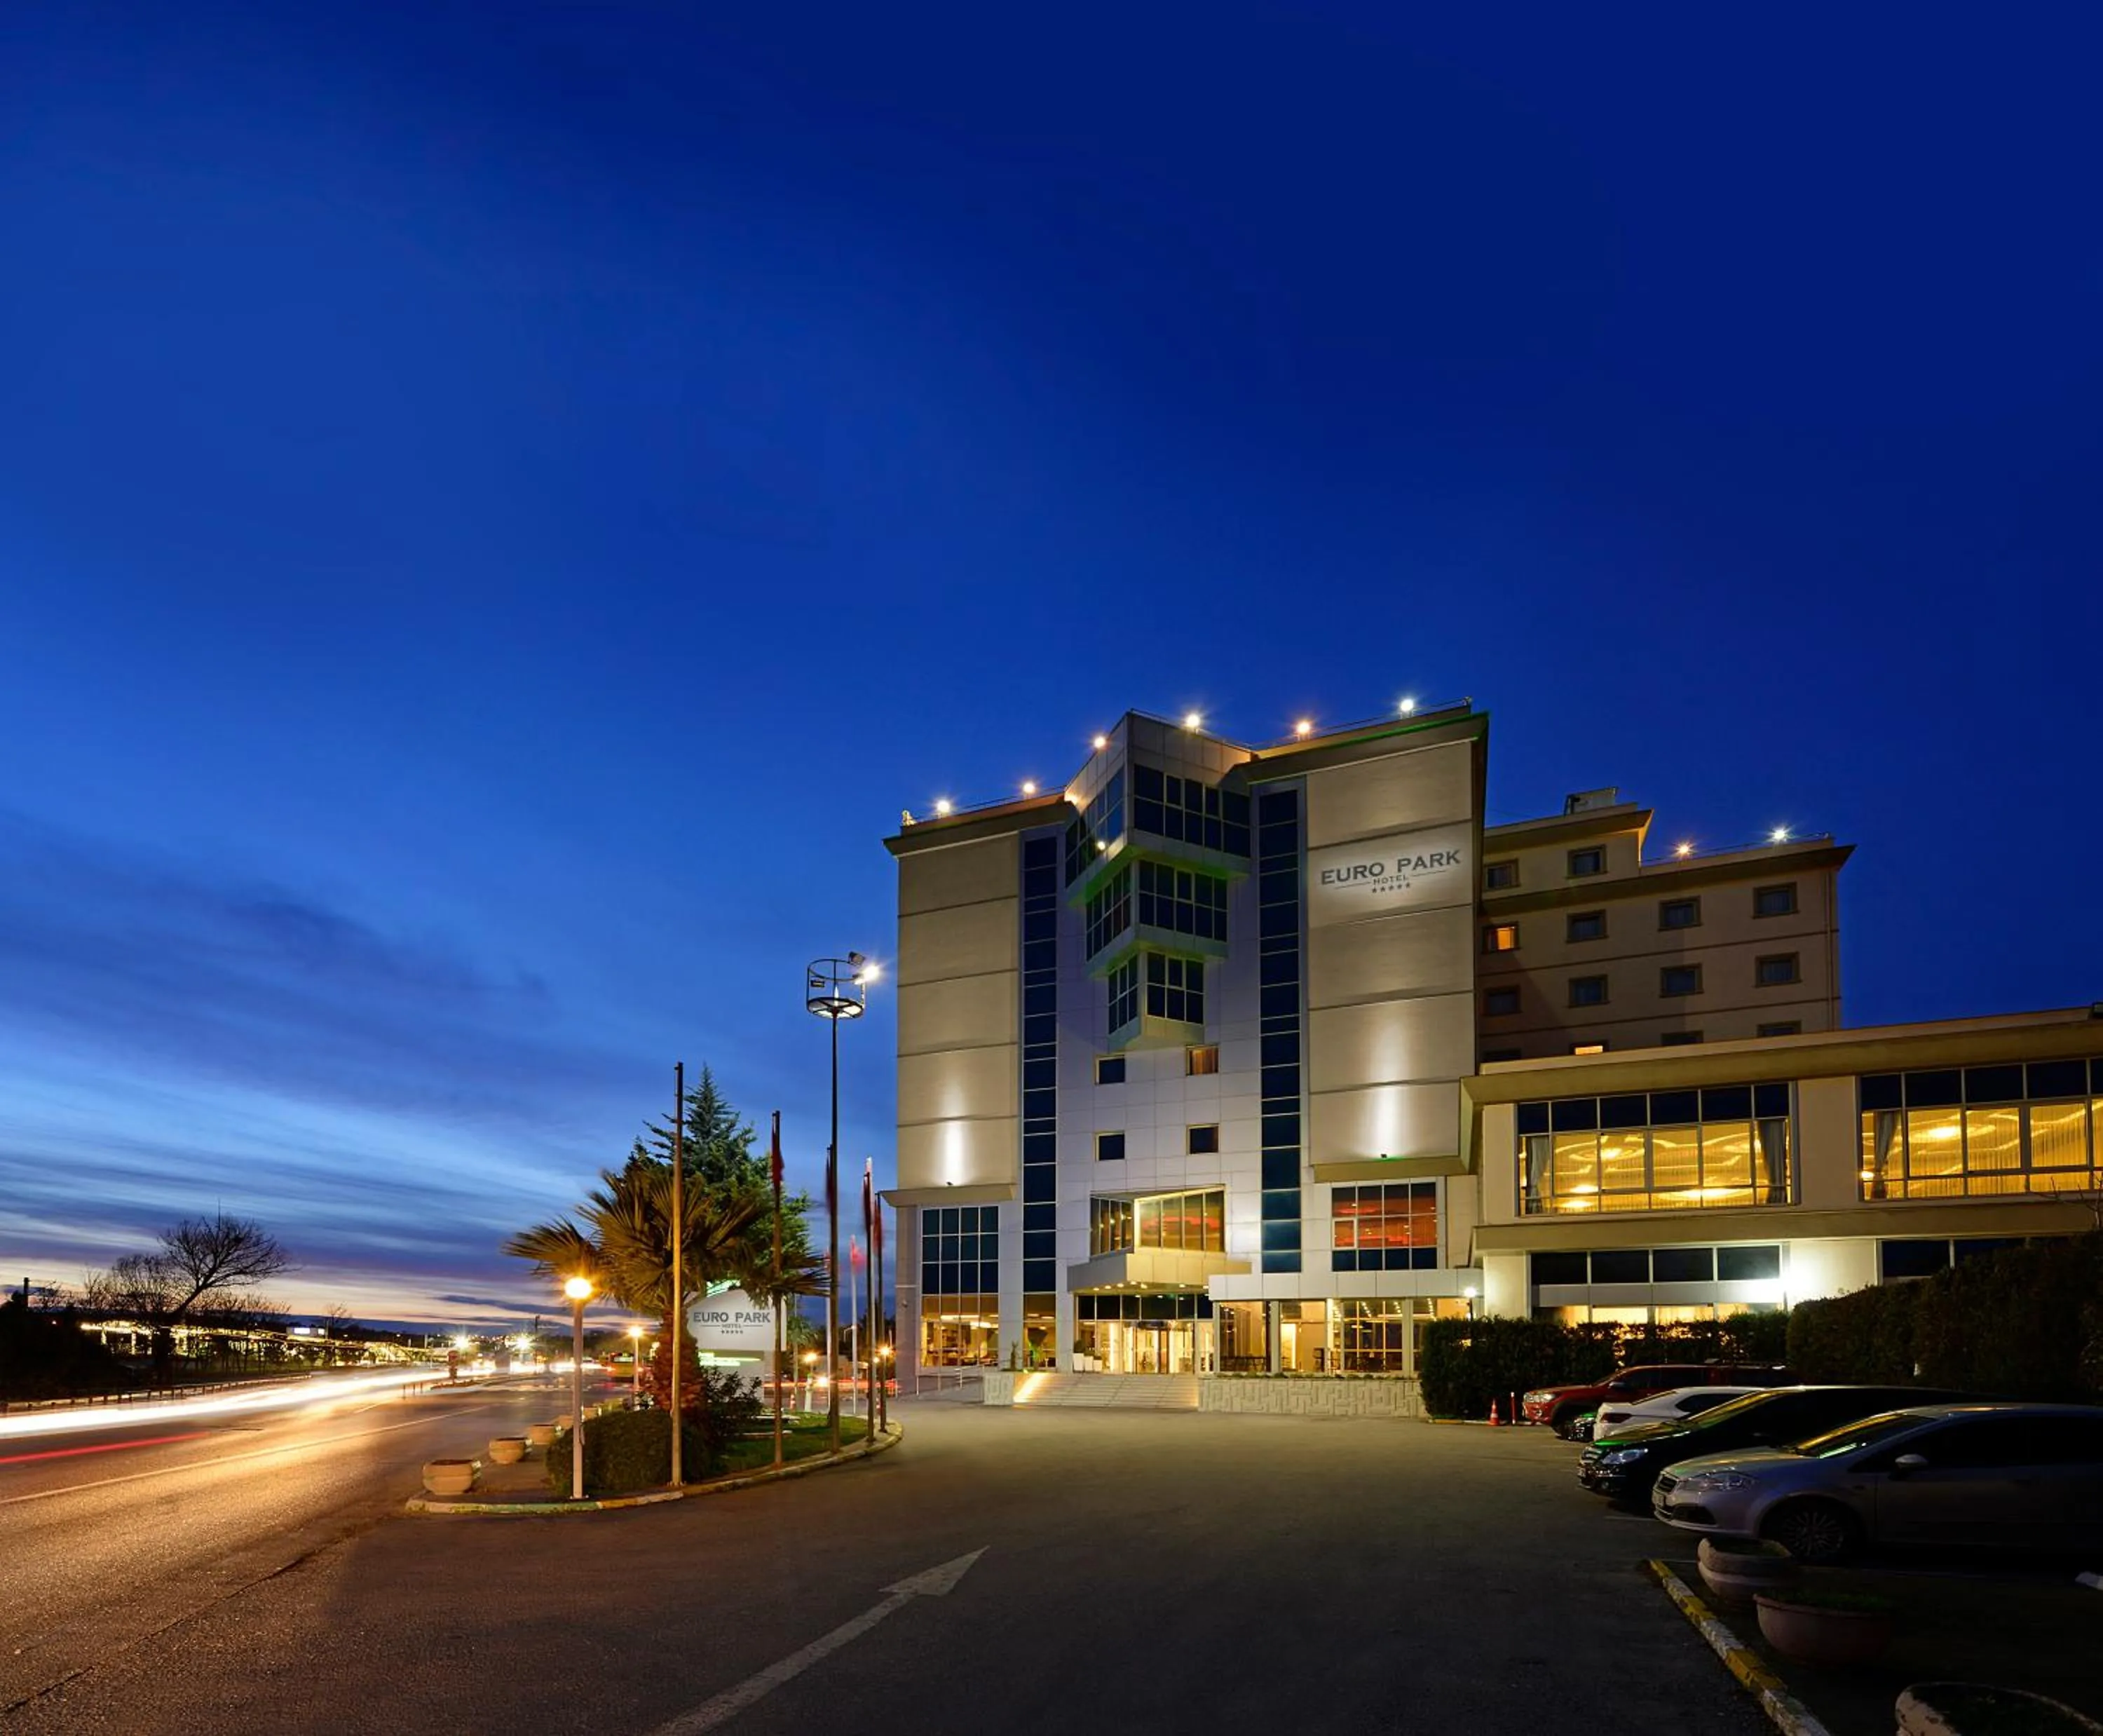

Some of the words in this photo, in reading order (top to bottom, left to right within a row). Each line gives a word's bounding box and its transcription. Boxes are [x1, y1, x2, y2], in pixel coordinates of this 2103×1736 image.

[1321, 862, 1384, 885] EURO
[1397, 849, 1461, 873] PARK
[1373, 874, 1409, 886] HOTEL
[693, 1312, 729, 1323] EURO
[735, 1312, 770, 1323] PARK
